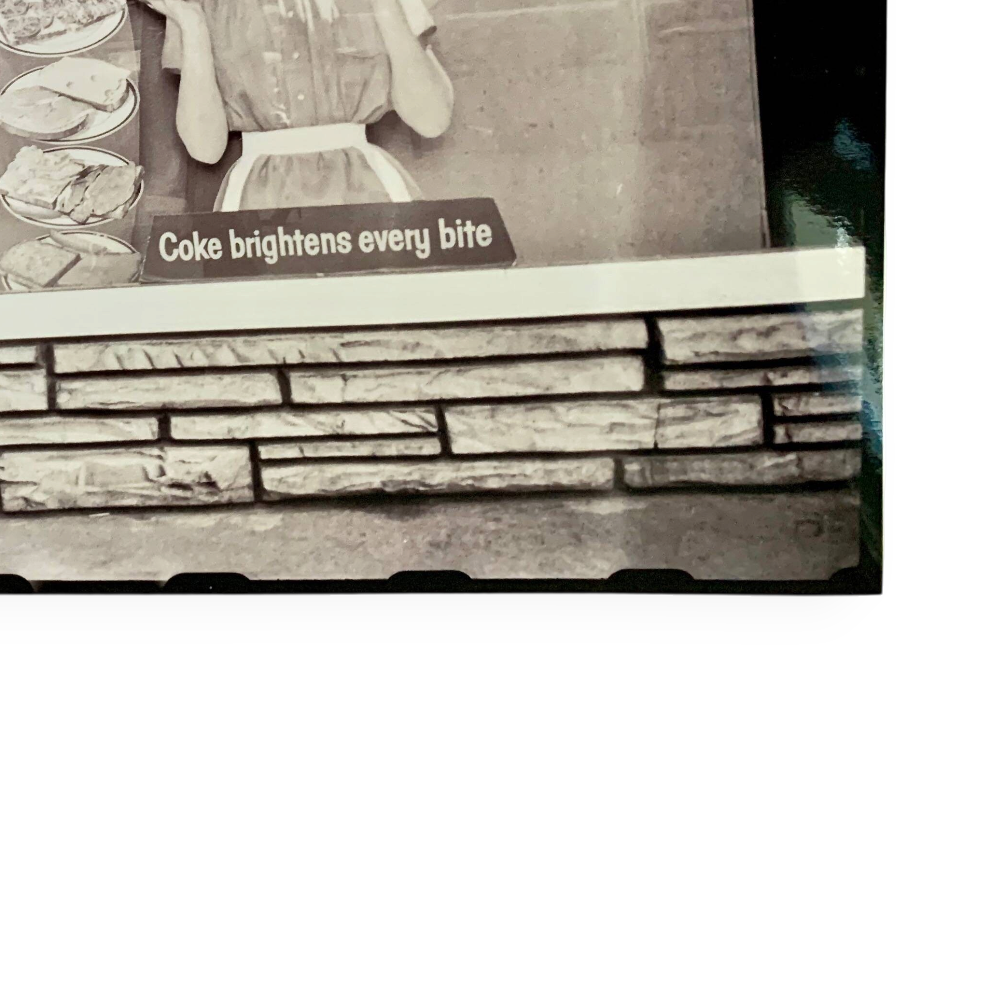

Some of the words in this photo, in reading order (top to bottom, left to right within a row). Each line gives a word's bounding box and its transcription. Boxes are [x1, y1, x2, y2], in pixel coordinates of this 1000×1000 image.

[159, 231, 223, 262] Coke
[228, 226, 353, 265] brightens
[358, 227, 431, 260] every
[438, 218, 493, 250] bite
